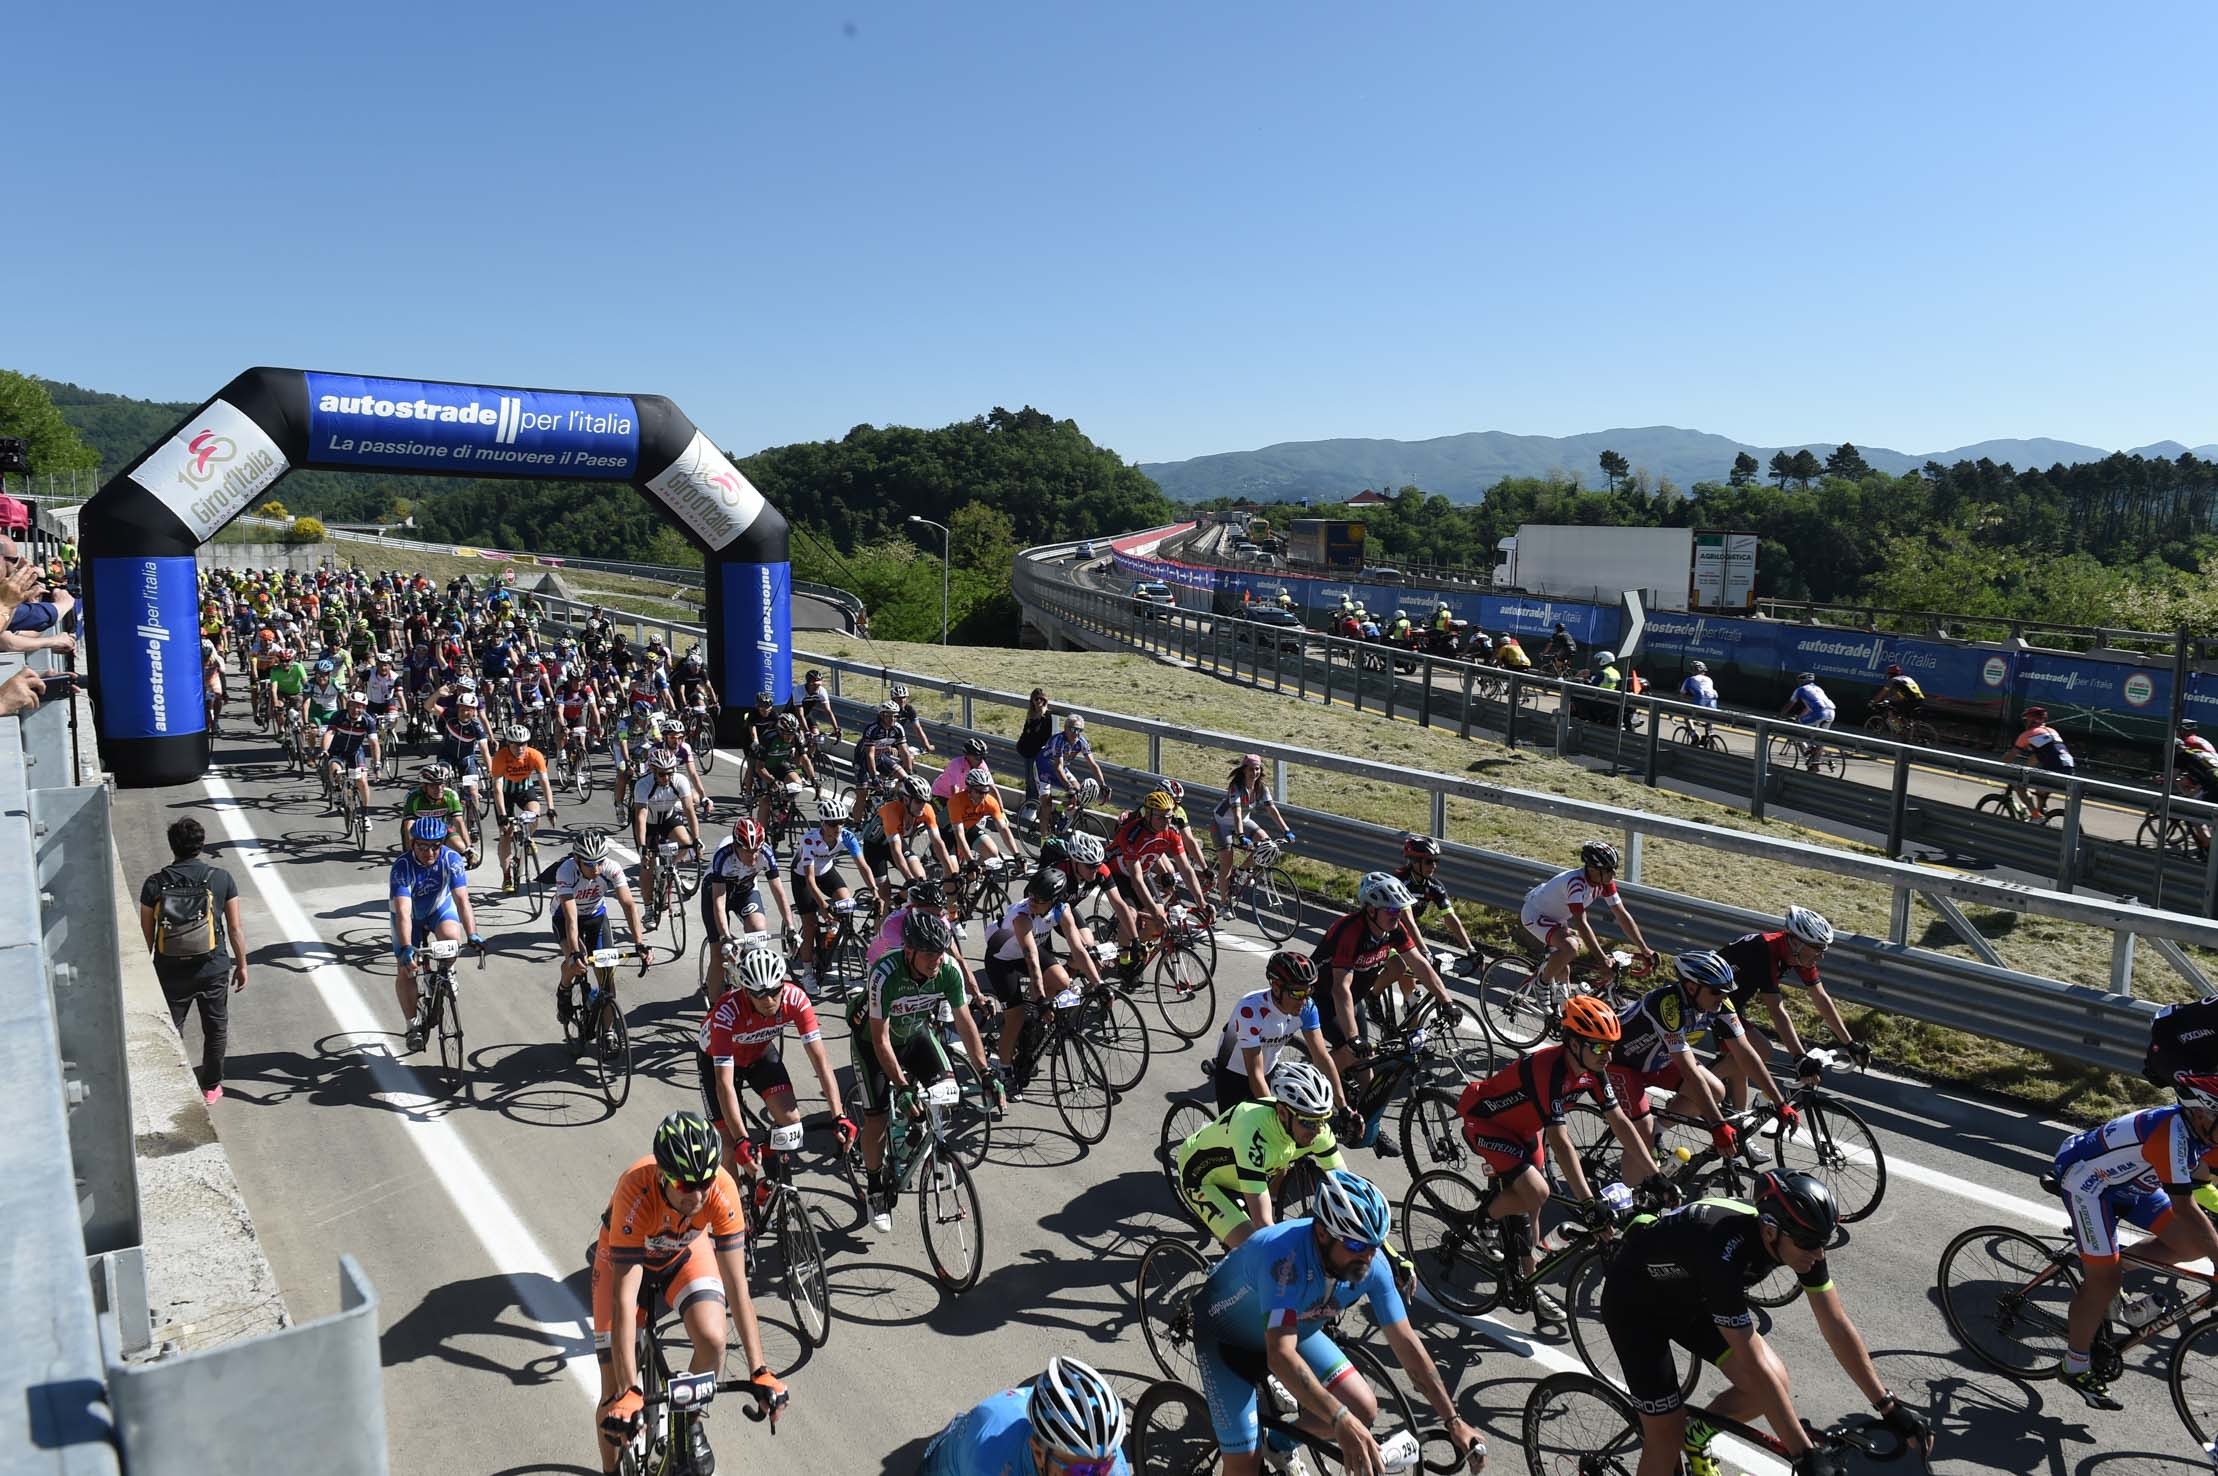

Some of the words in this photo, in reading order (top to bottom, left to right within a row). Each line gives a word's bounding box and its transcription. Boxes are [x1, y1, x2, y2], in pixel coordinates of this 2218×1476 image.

[319, 395, 497, 425] autostrade
[520, 411, 563, 434] per
[568, 410, 631, 435] l'italia
[329, 435, 354, 451] La
[358, 439, 448, 458] passione
[452, 444, 471, 459] di
[475, 449, 555, 464] muovere
[558, 451, 572, 465] il
[574, 452, 628, 468] Paese
[190, 489, 229, 524] Giro
[223, 450, 273, 497] d'Italia
[142, 561, 158, 600] l'italia
[147, 603, 162, 627] per
[762, 567, 774, 642] autostrade
[1500, 605, 1544, 619] autostrade
[1644, 620, 1694, 636] tostrade
[764, 651, 773, 670] per
[1797, 638, 1871, 658] autostrade
[1879, 649, 1900, 664] per
[146, 639, 167, 732] autostrade
[2019, 671, 2068, 684] autostrade
[713, 997, 741, 1032] 1907
[789, 1129, 800, 1142] 334
[2118, 1161, 2136, 1172] FILM
